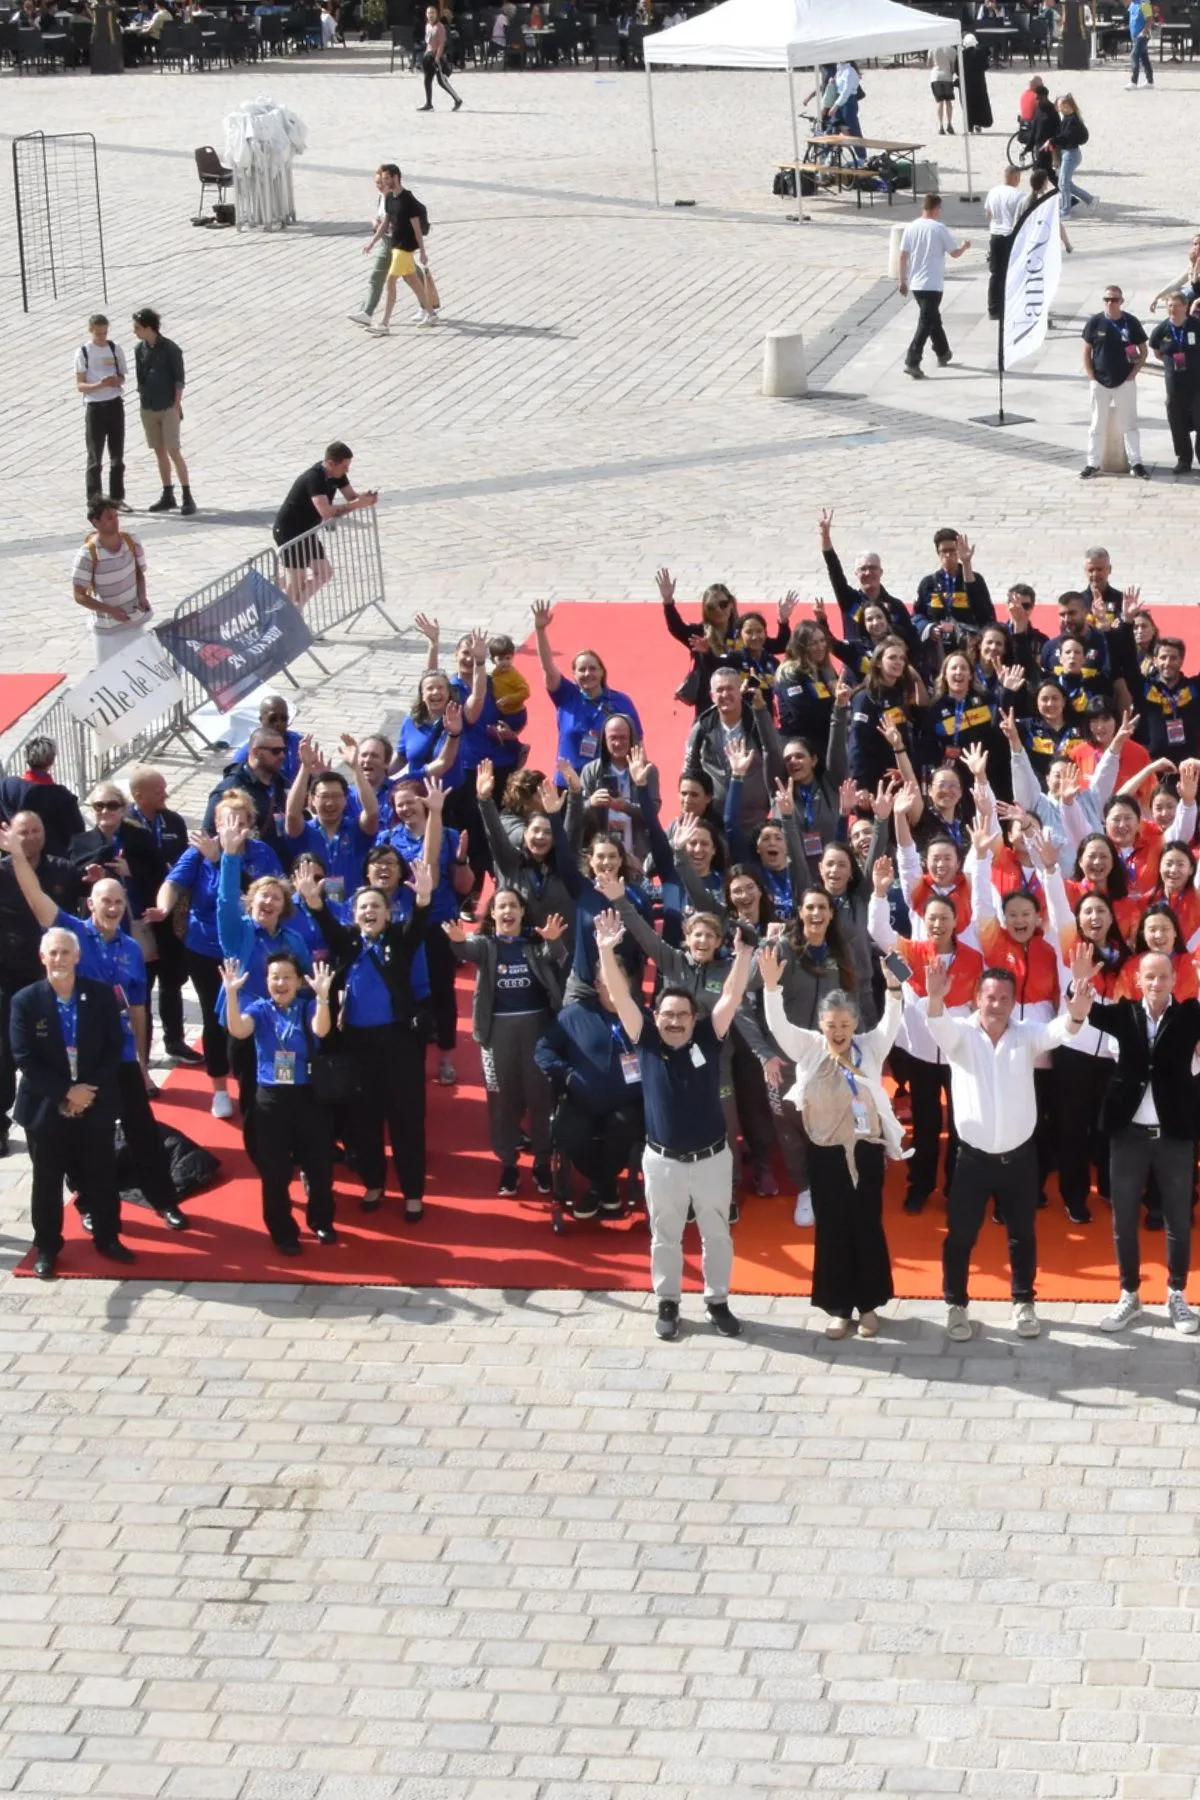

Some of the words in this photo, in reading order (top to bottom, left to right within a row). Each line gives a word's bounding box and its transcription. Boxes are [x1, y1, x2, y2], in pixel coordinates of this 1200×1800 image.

[1012, 218, 1052, 346] Nancy
[219, 603, 260, 641] NANCY
[83, 685, 135, 728] ville
[122, 669, 154, 699] de
